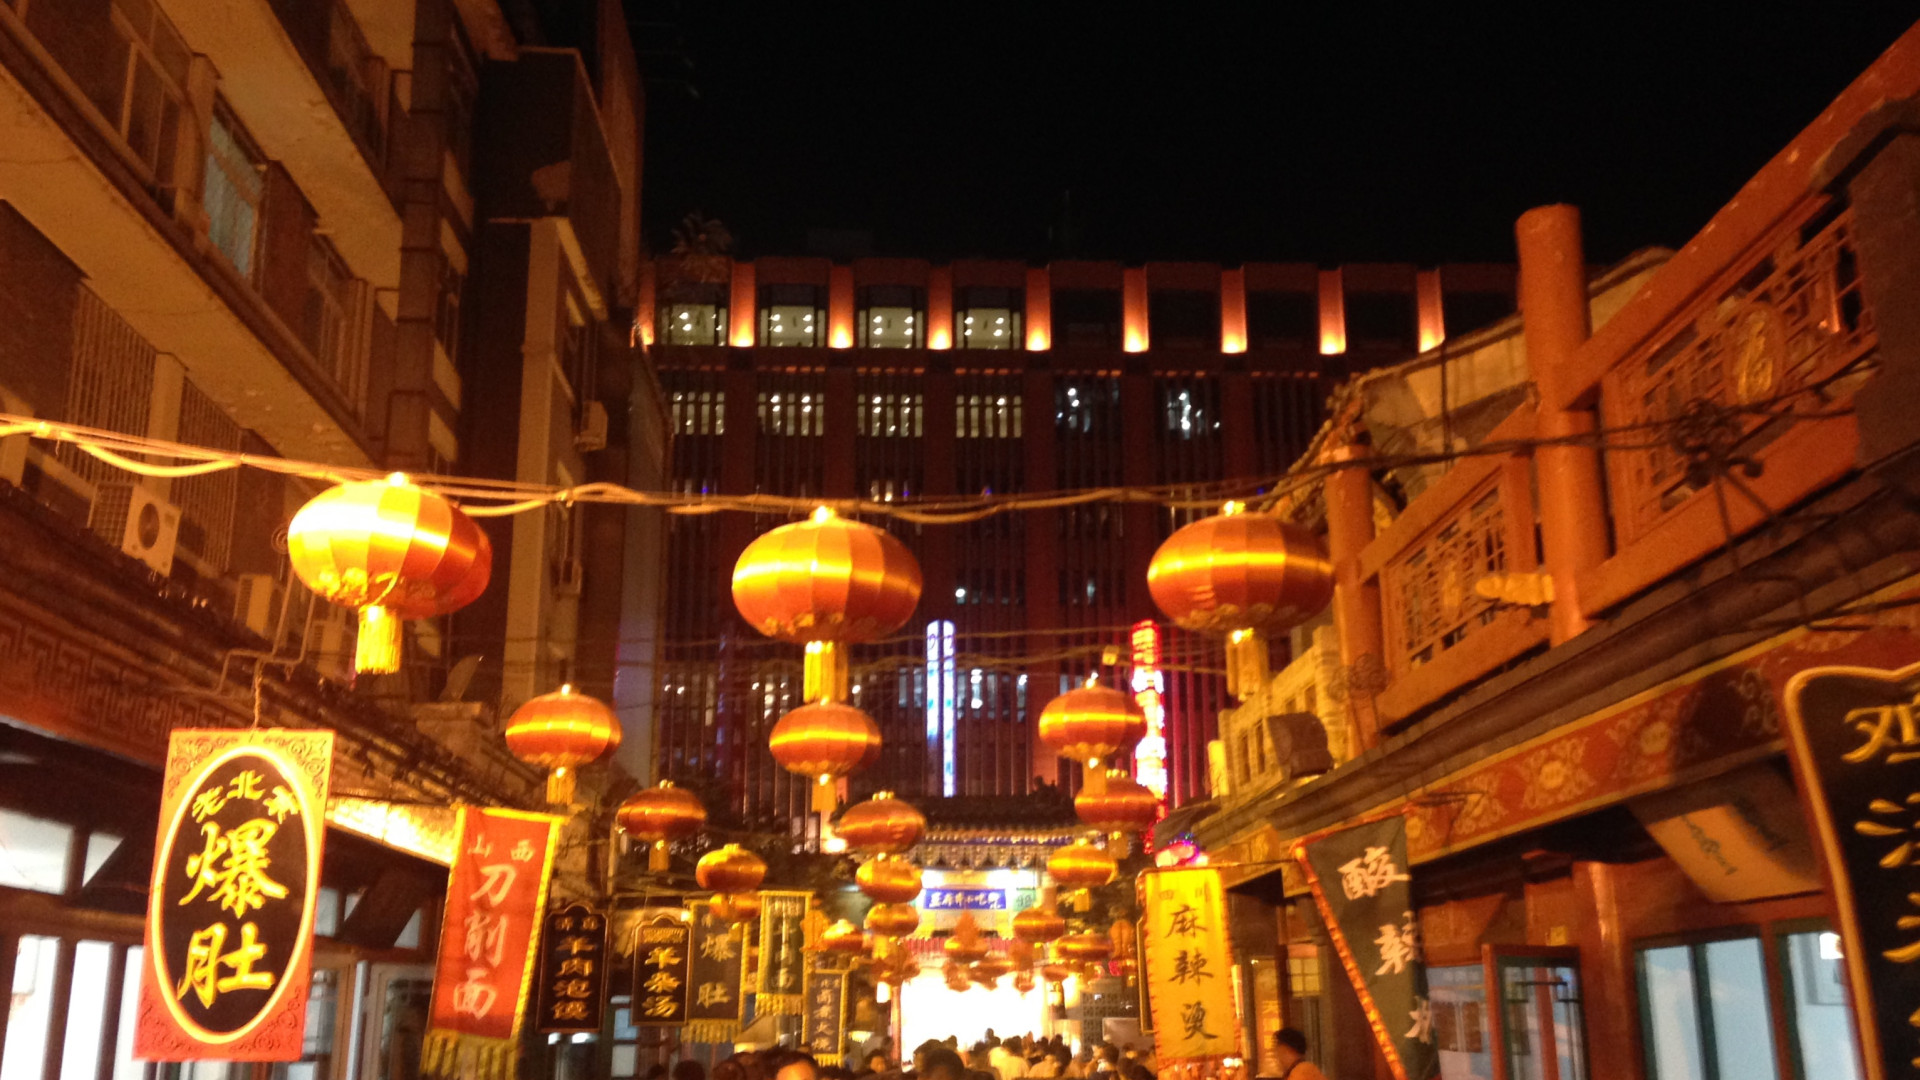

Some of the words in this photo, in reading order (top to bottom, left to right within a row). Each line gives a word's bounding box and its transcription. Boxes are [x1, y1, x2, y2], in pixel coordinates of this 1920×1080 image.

[191, 769, 300, 825] 老北京
[467, 834, 537, 863] 山西
[177, 818, 289, 1010] 爆肚
[1158, 886, 1206, 901] 四川
[453, 864, 518, 1020] 刀削面
[551, 935, 597, 1021] 羊肉泡馍
[696, 933, 737, 1009] 爆肚
[1164, 904, 1219, 1041] 麻辣烫
[641, 946, 682, 1018] 羊杂汤
